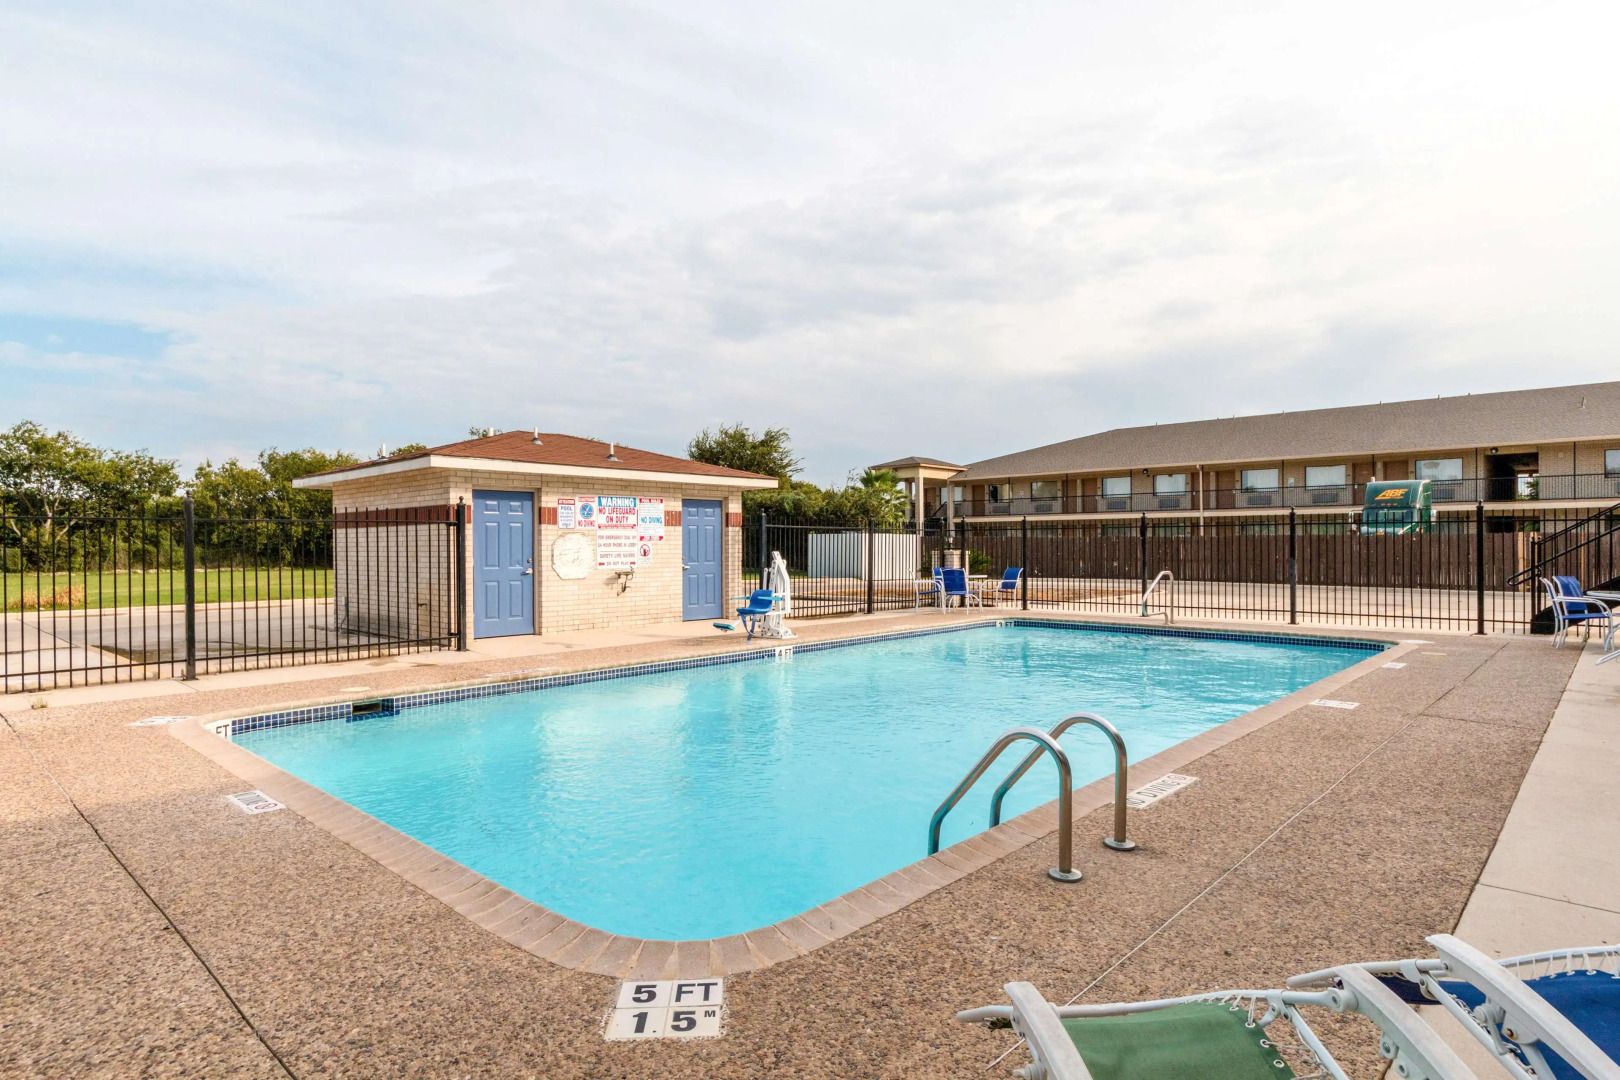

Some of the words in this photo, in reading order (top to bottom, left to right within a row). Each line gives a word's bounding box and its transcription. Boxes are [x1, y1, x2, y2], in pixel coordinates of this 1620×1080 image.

[1375, 489, 1409, 500] ABF
[601, 497, 635, 507] WARNING
[599, 507, 606, 515] NO
[608, 507, 636, 515] LIFEGUARD
[632, 984, 657, 1003] 5
[674, 982, 718, 1003] FT
